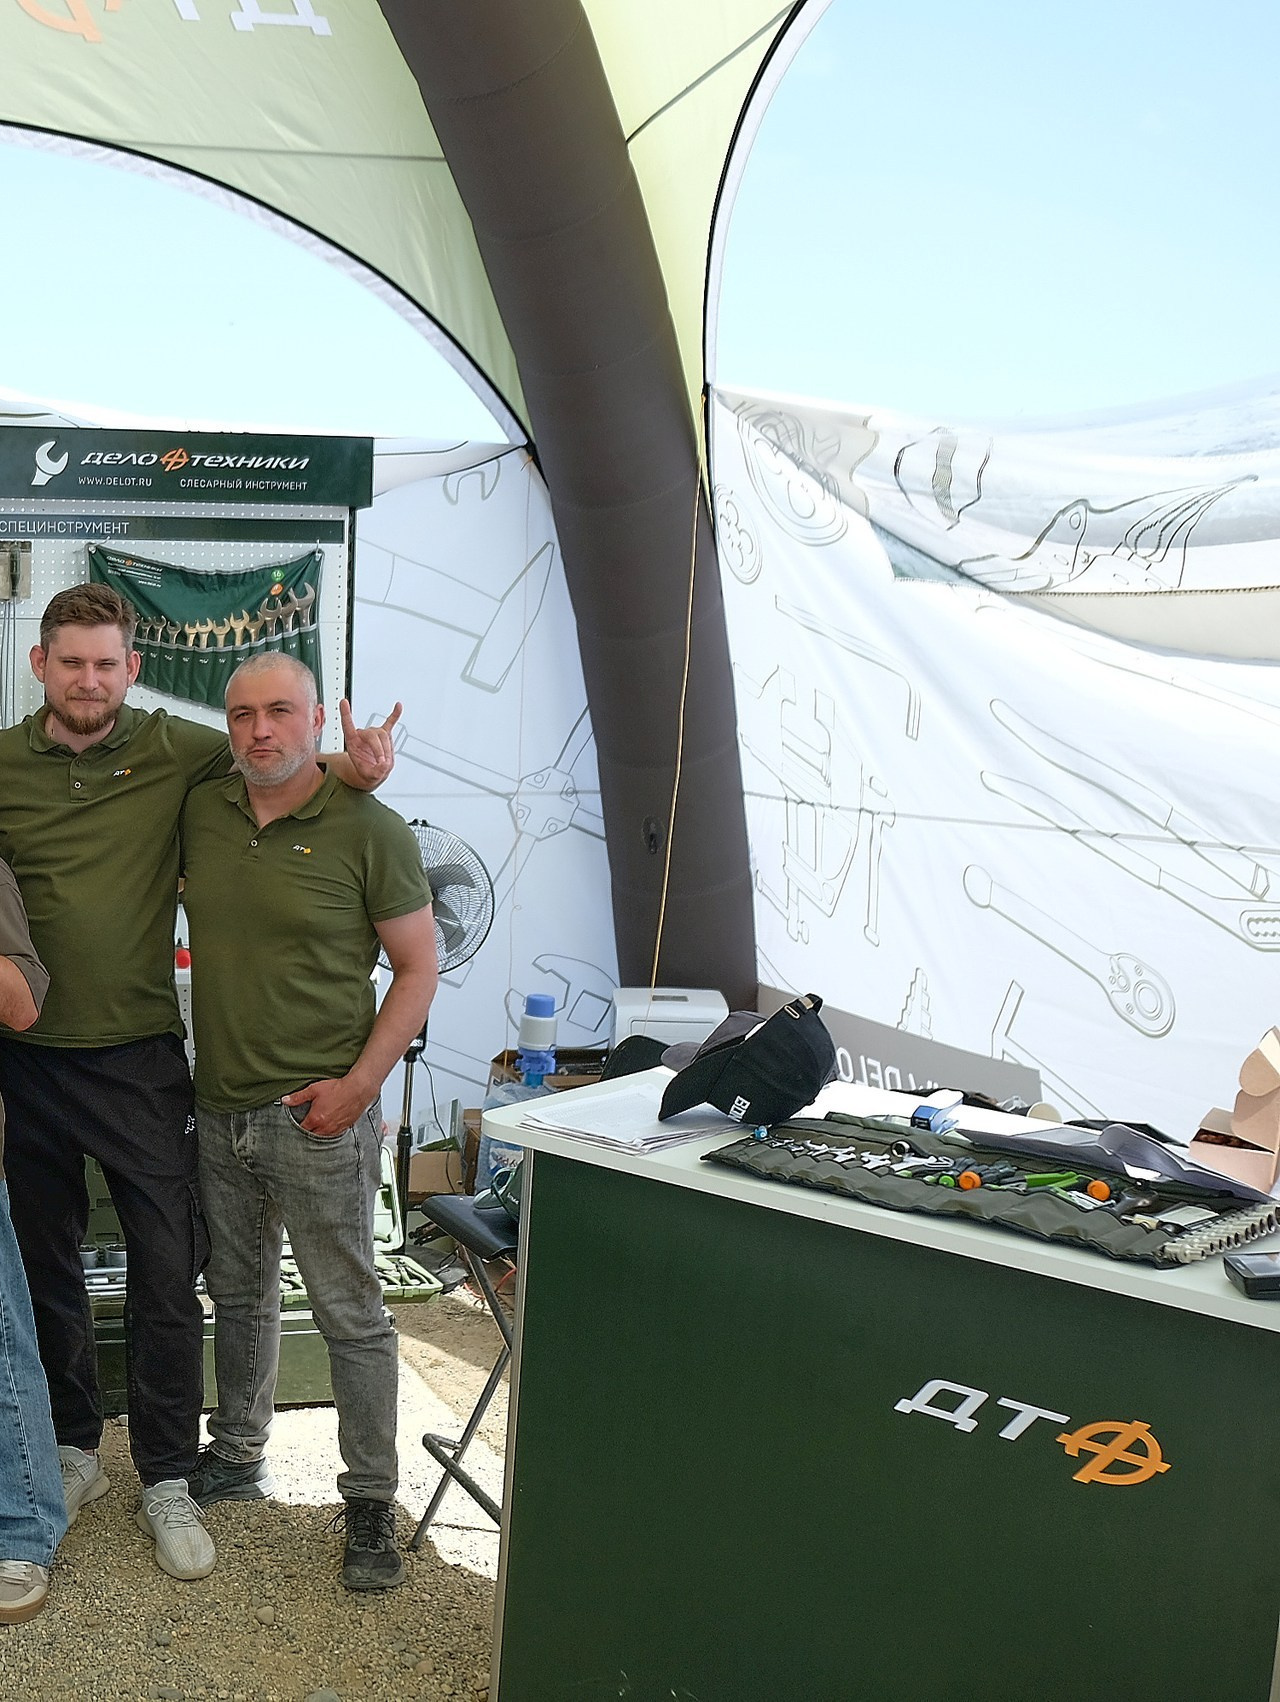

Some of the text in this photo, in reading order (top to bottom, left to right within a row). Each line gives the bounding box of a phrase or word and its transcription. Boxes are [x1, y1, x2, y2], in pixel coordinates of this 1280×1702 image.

[78, 475, 152, 487] WWW.DELOT.RU
[180, 478, 308, 491] СЛЕСАРНЫЙ ИНСТРУМЕНТ
